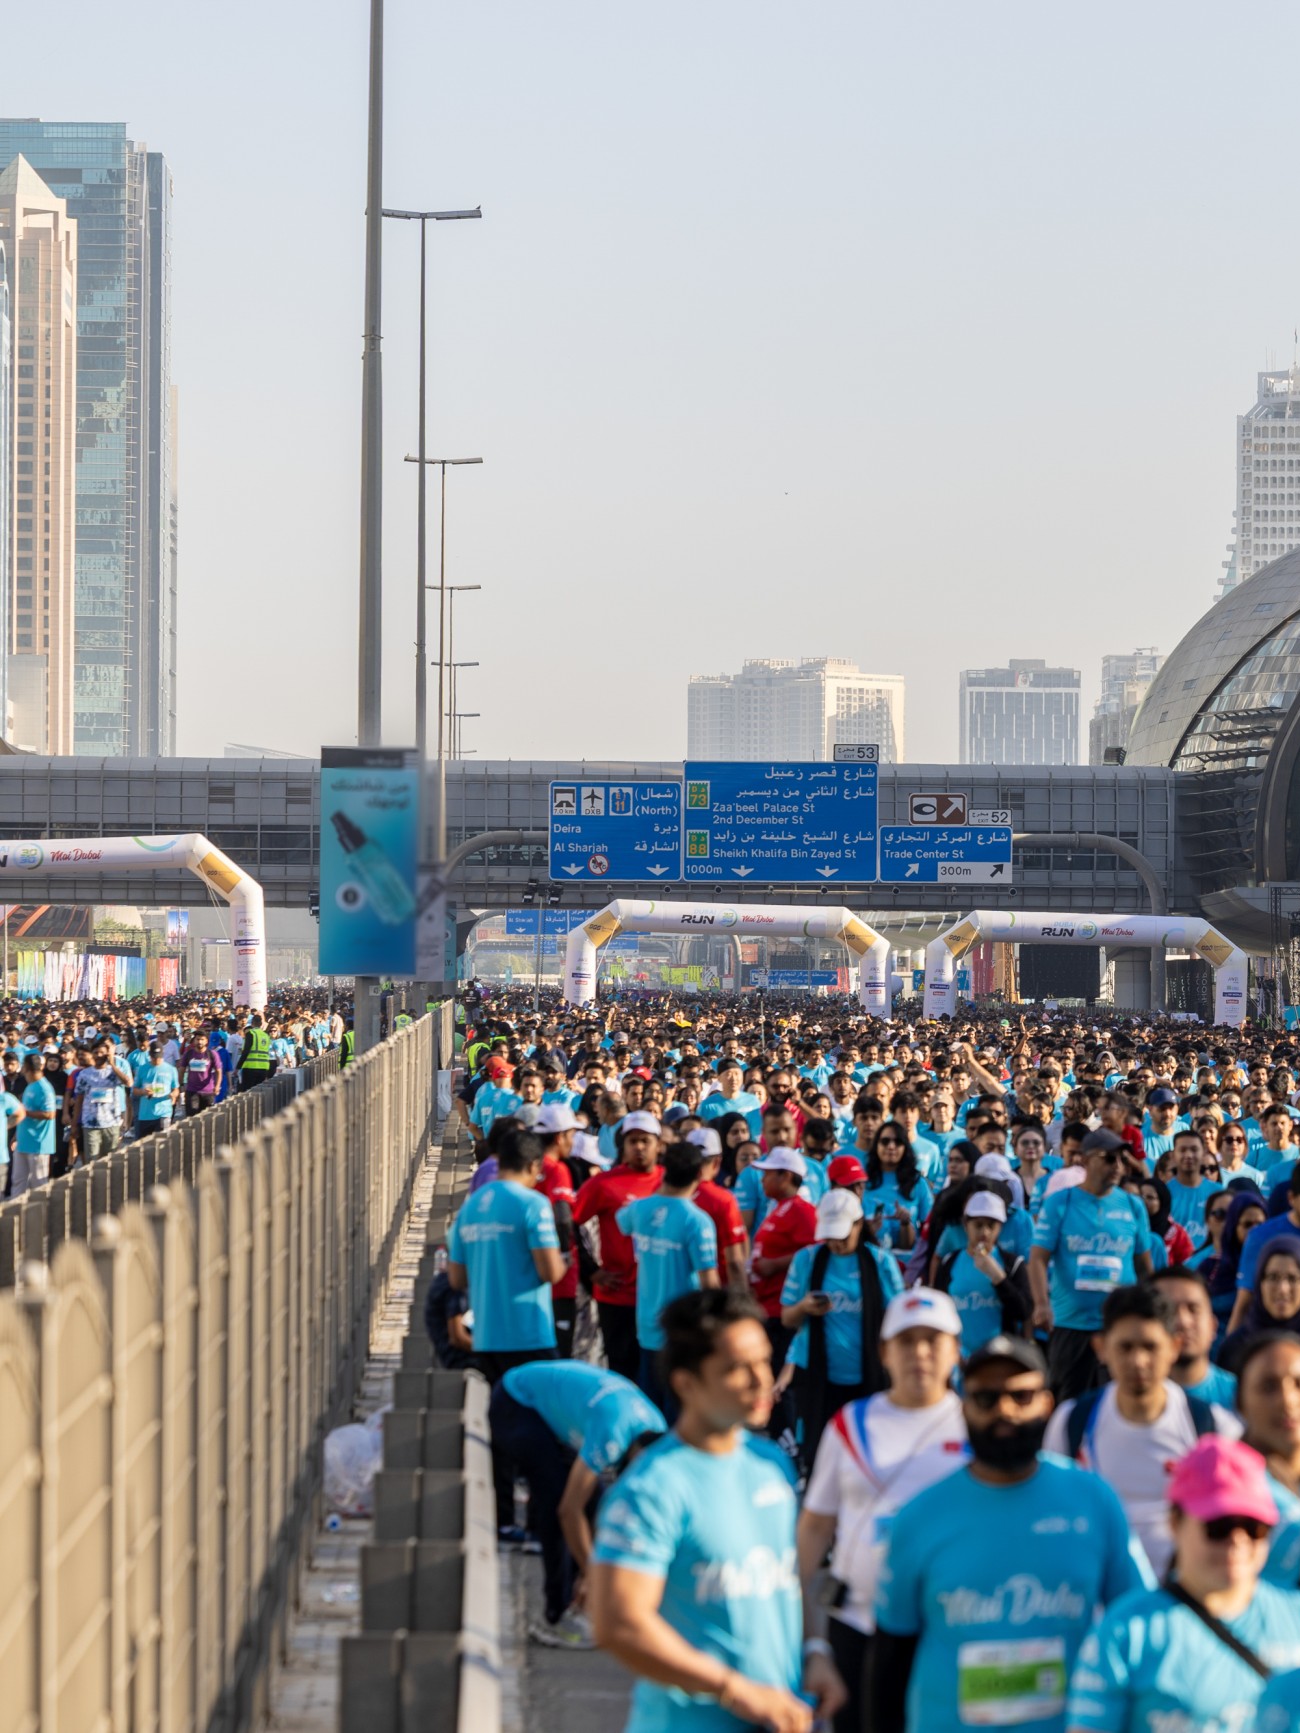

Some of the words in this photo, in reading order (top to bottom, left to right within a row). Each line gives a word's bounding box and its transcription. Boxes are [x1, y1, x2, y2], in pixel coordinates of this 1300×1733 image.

[857, 747, 875, 759] 53
[764, 766, 804, 780] زعبيل
[808, 766, 837, 780] قصر
[843, 767, 875, 781] شارع
[635, 788, 678, 801] (شمال)
[736, 787, 779, 799] ديسمبر
[782, 788, 800, 799] من
[805, 786, 837, 801] الثاني
[843, 786, 875, 800] شارع
[690, 794, 707, 806] 73
[615, 801, 625, 812] 11
[635, 805, 678, 817] (North)
[713, 803, 758, 812] Zaa'beel
[763, 803, 799, 812] Palace
[802, 803, 815, 812] St
[713, 815, 733, 824] 2nd
[736, 815, 788, 824] December
[791, 815, 804, 824] St
[991, 811, 1008, 823] 52
[554, 823, 582, 833] Deira
[654, 823, 679, 834] ديرة
[713, 830, 736, 843] زايد
[740, 832, 756, 843] بن
[760, 830, 797, 844] خليفة
[802, 830, 837, 845] الشيخ
[843, 830, 875, 844] شارع
[884, 831, 930, 844] التجاري
[934, 831, 971, 844] المركز
[976, 831, 1008, 845] شارع
[553, 843, 565, 852] Al
[568, 843, 608, 854] Sharjah
[634, 841, 679, 854] الشارقة
[690, 844, 707, 855] 88
[50, 851, 72, 862] Mai
[73, 848, 104, 862] Dubai
[713, 849, 748, 858] Sheikh
[751, 849, 787, 858] Khalifa
[790, 849, 808, 858] Bin
[811, 849, 841, 860] Zayed
[844, 849, 857, 858] St
[884, 850, 913, 859] Trade
[915, 850, 949, 859] Center
[952, 850, 964, 859] St
[686, 865, 723, 874] 1000m
[940, 867, 972, 875] 300m
[681, 914, 715, 924] RUN
[1041, 927, 1075, 937] RUN
[1101, 928, 1115, 936] Mai
[1116, 928, 1135, 936] Dubai
